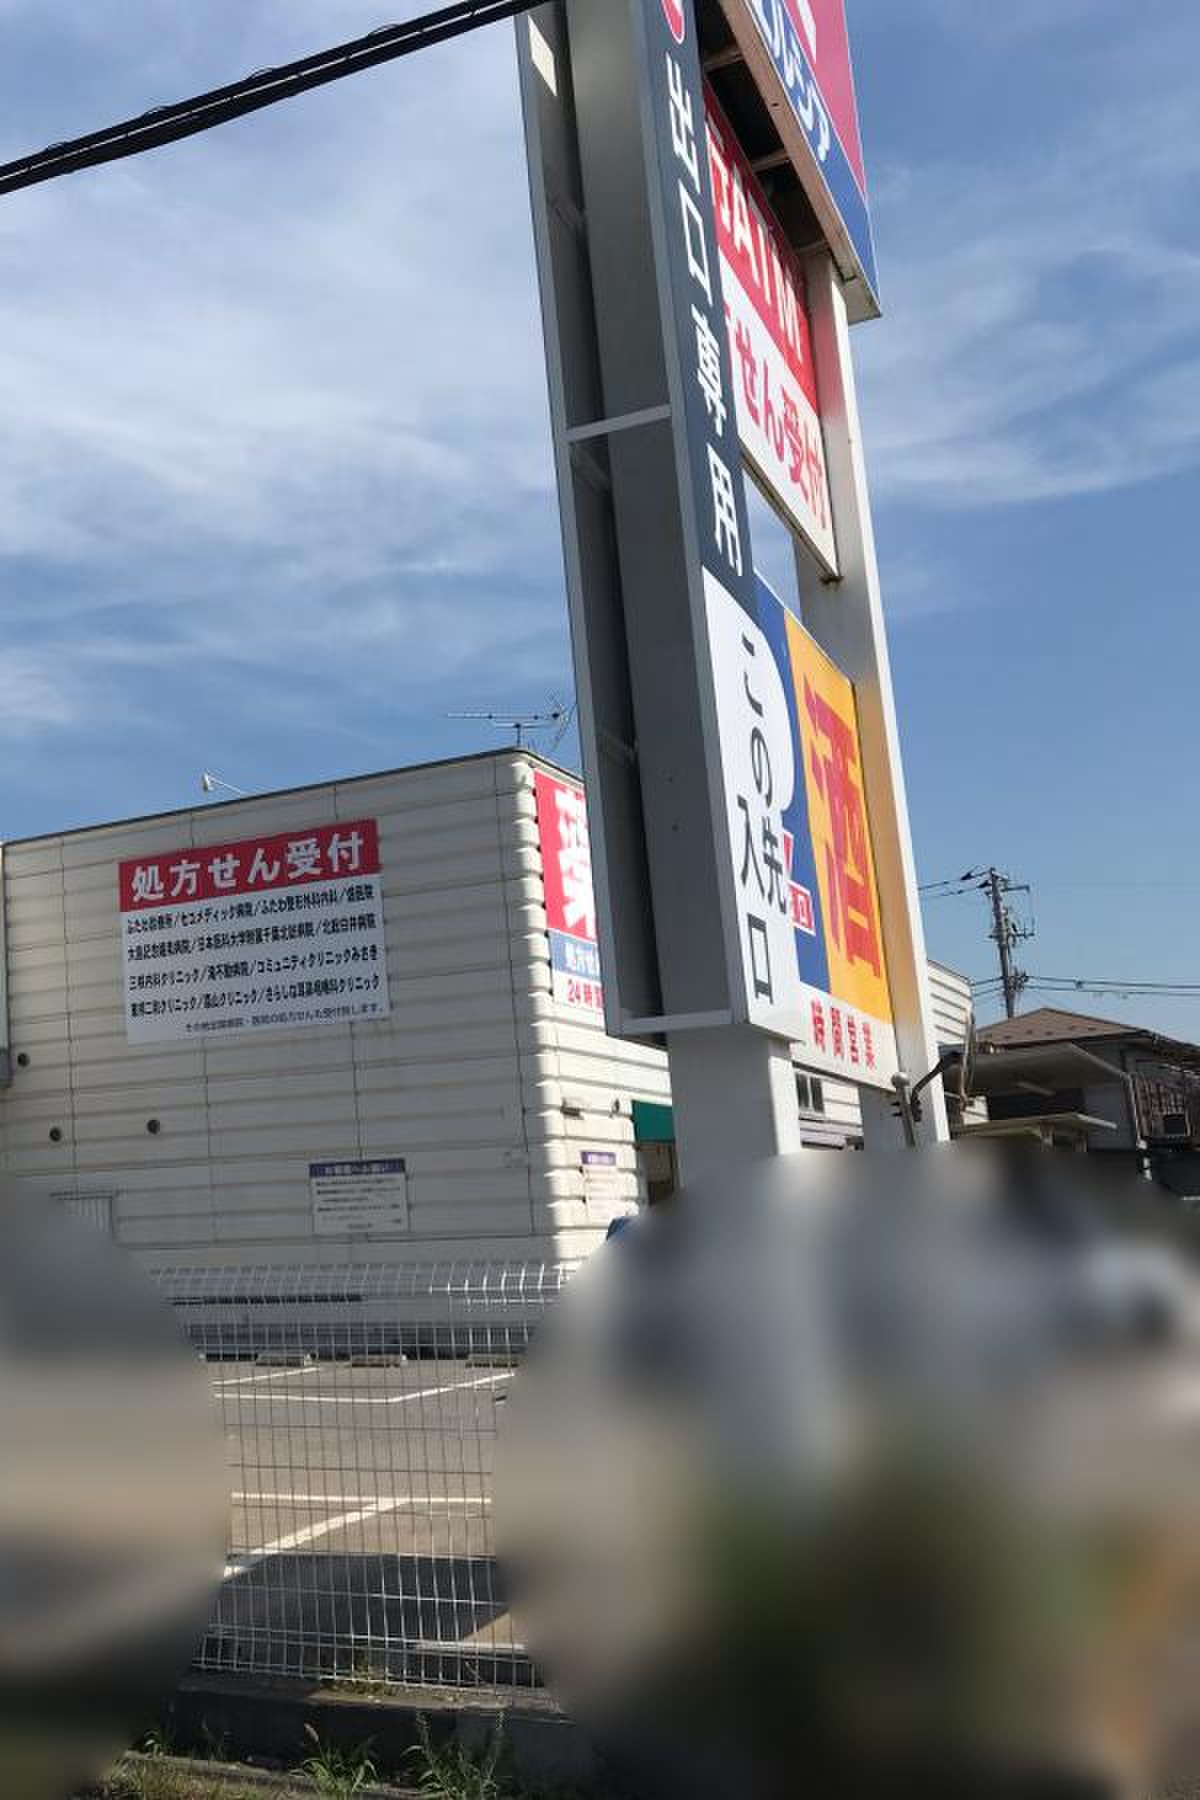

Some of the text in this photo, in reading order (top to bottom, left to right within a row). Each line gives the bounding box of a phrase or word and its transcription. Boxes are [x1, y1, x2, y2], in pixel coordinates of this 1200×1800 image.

[666, 51, 743, 577] 出口専用
[131, 831, 364, 902] 処方せん受付
[736, 795, 774, 1006] 入口
[741, 631, 787, 916] この先
[803, 673, 881, 980] 酒
